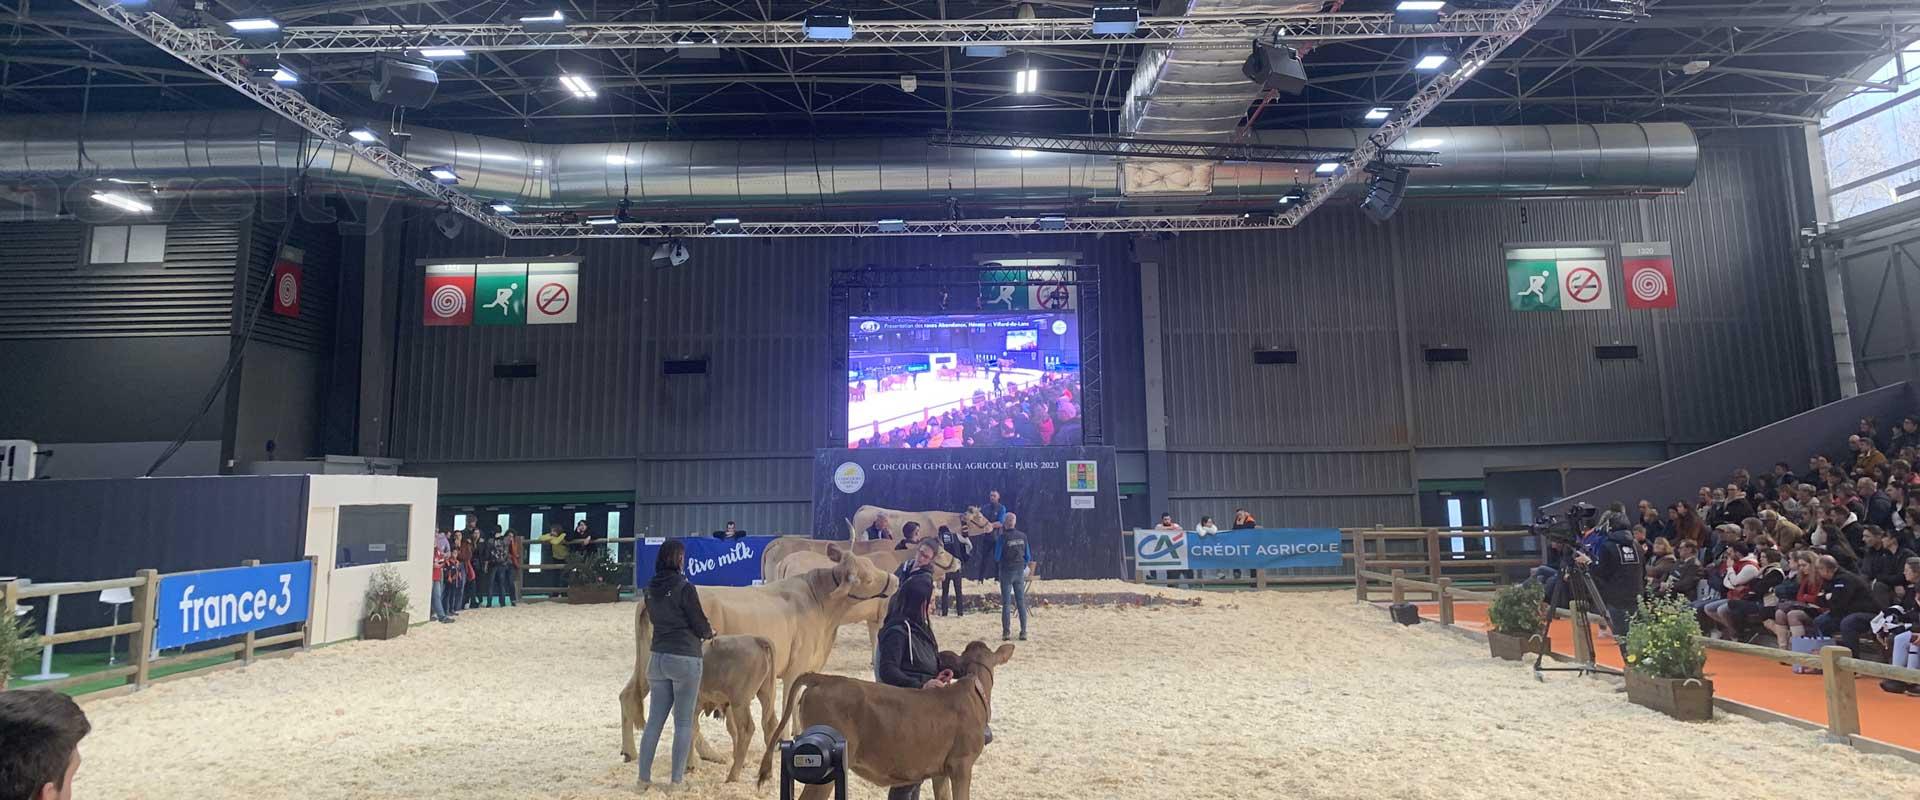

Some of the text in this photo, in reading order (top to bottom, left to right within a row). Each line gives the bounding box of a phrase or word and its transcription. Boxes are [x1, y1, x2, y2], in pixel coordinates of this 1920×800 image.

[872, 463, 922, 471] CONCOURS
[964, 462, 1009, 470] AGRICOLE
[1015, 460, 1039, 471] PARIS
[1040, 461, 1060, 469] 2023
[1191, 543, 1339, 557] CRÉDIT AGRICOLE
[687, 557, 716, 576] live
[717, 541, 754, 567] milk
